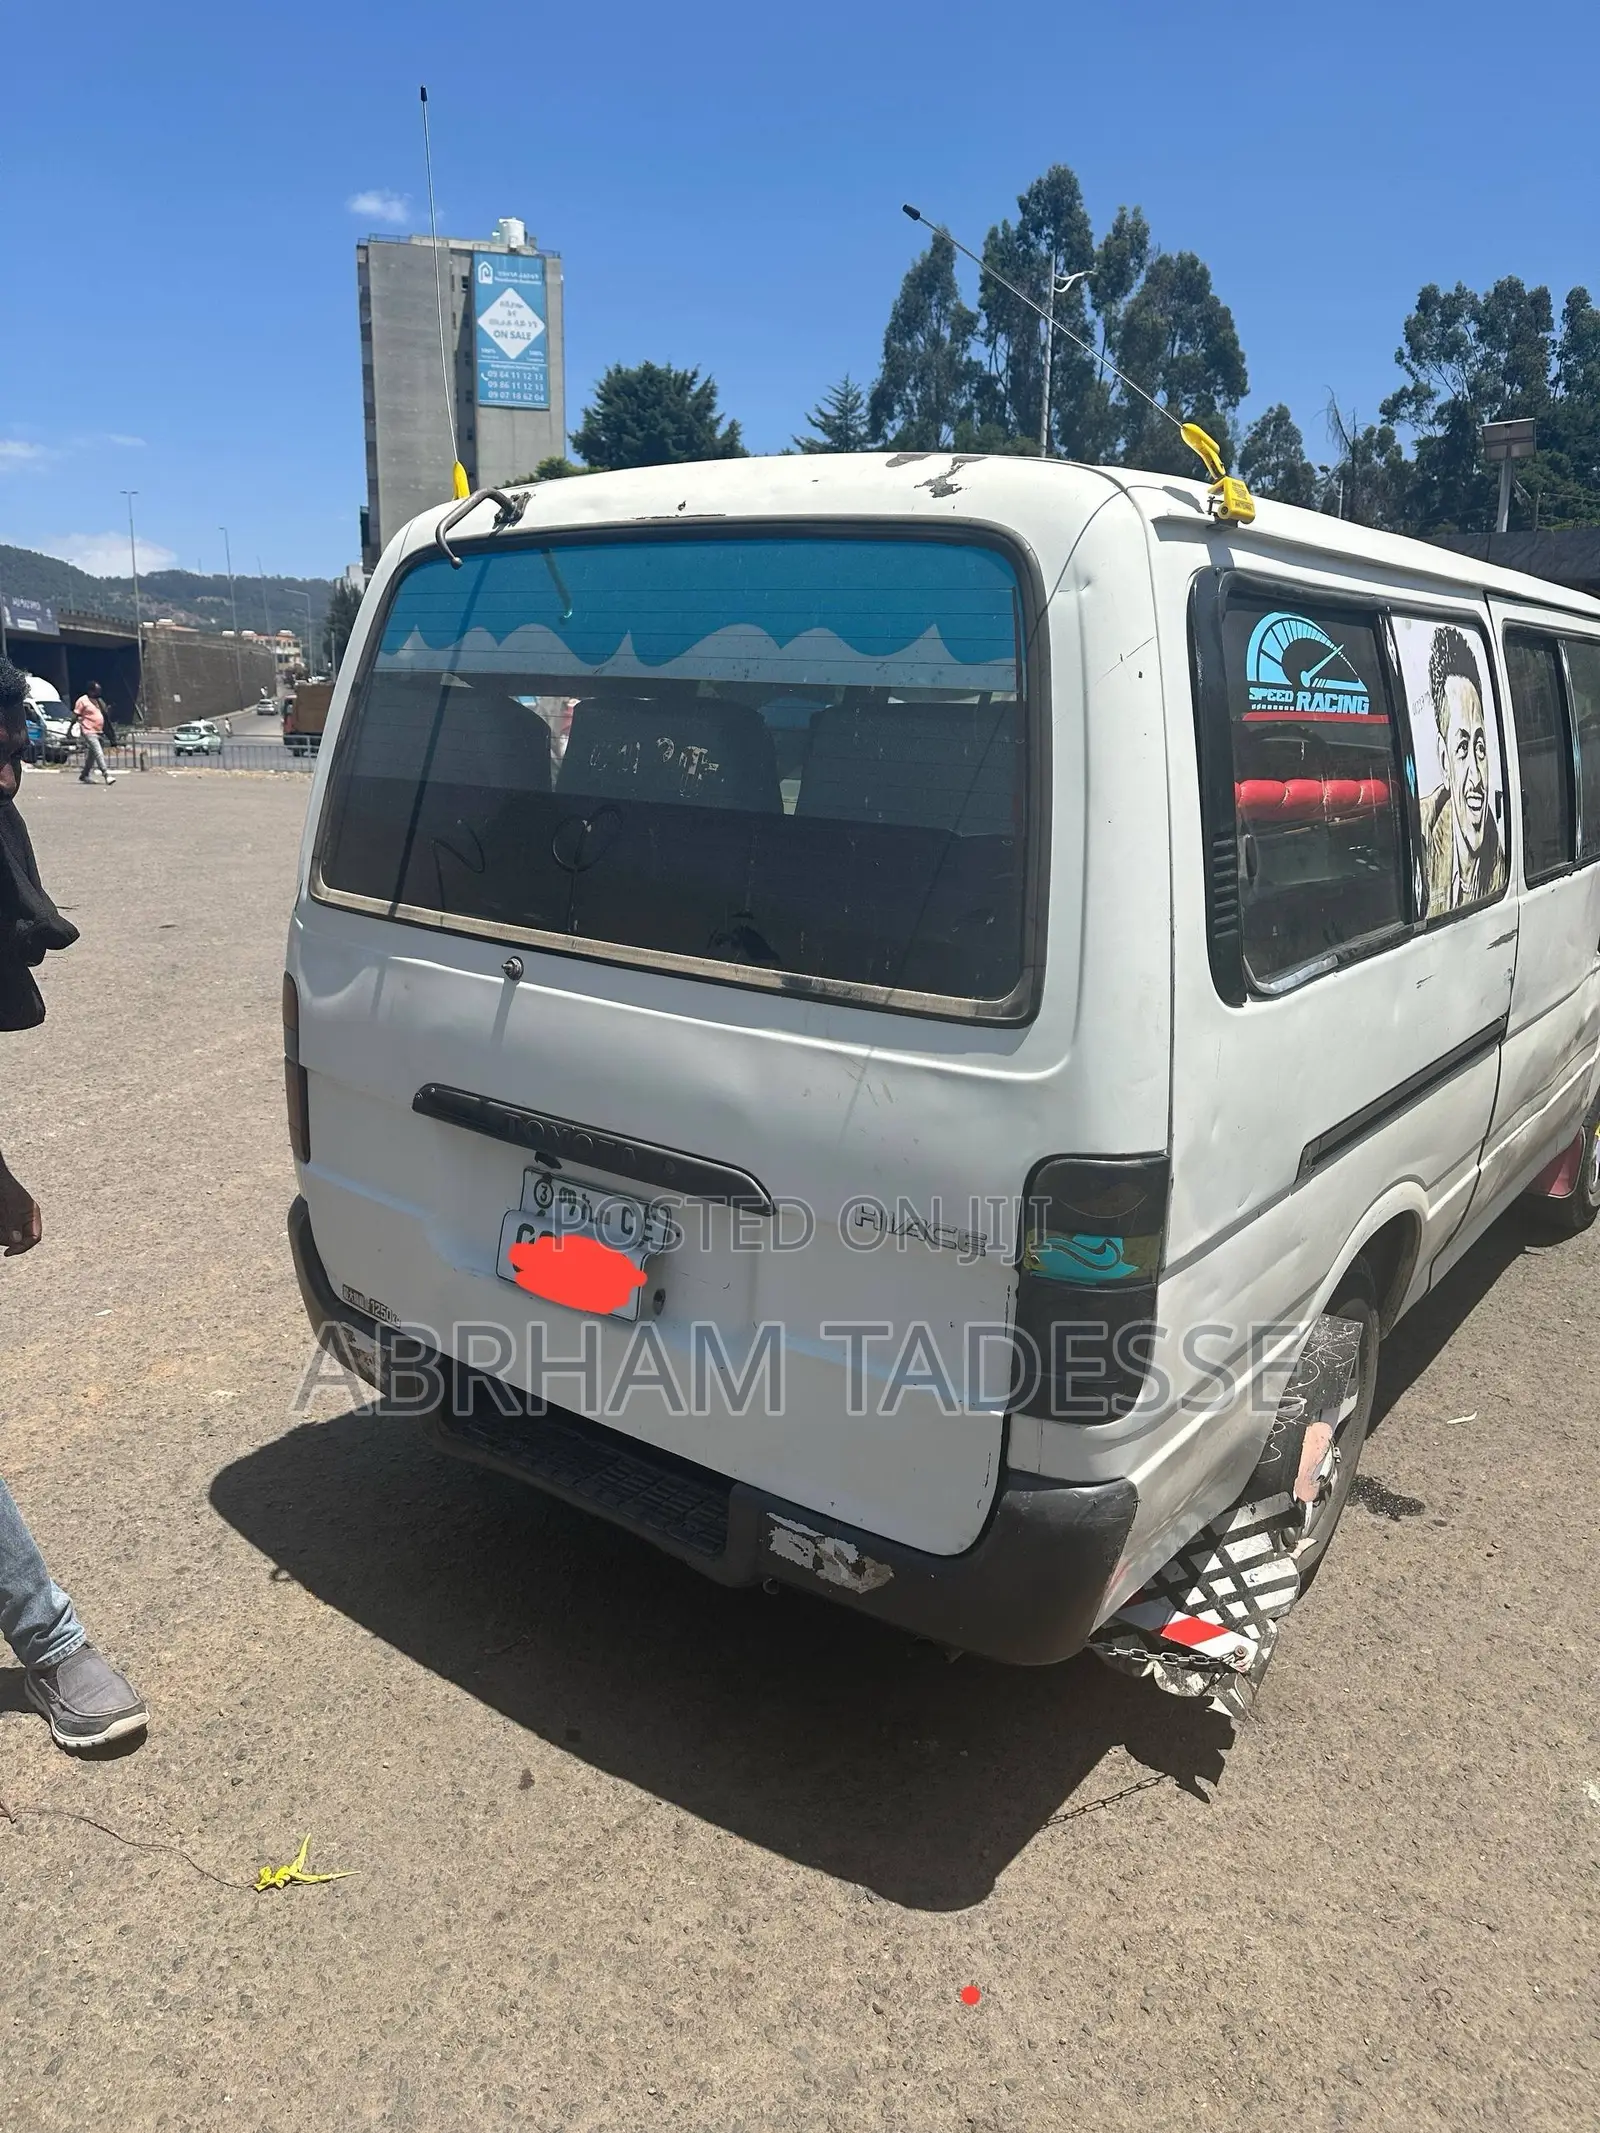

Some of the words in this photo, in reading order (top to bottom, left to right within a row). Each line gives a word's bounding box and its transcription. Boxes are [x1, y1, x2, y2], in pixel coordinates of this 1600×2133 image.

[493, 329, 508, 339] ON
[510, 330, 531, 341] SALE
[1248, 687, 1294, 703] SPEED
[1295, 691, 1370, 715] RACING
[504, 1111, 638, 1166] TOYOTA
[855, 1205, 988, 1257] HIACE
